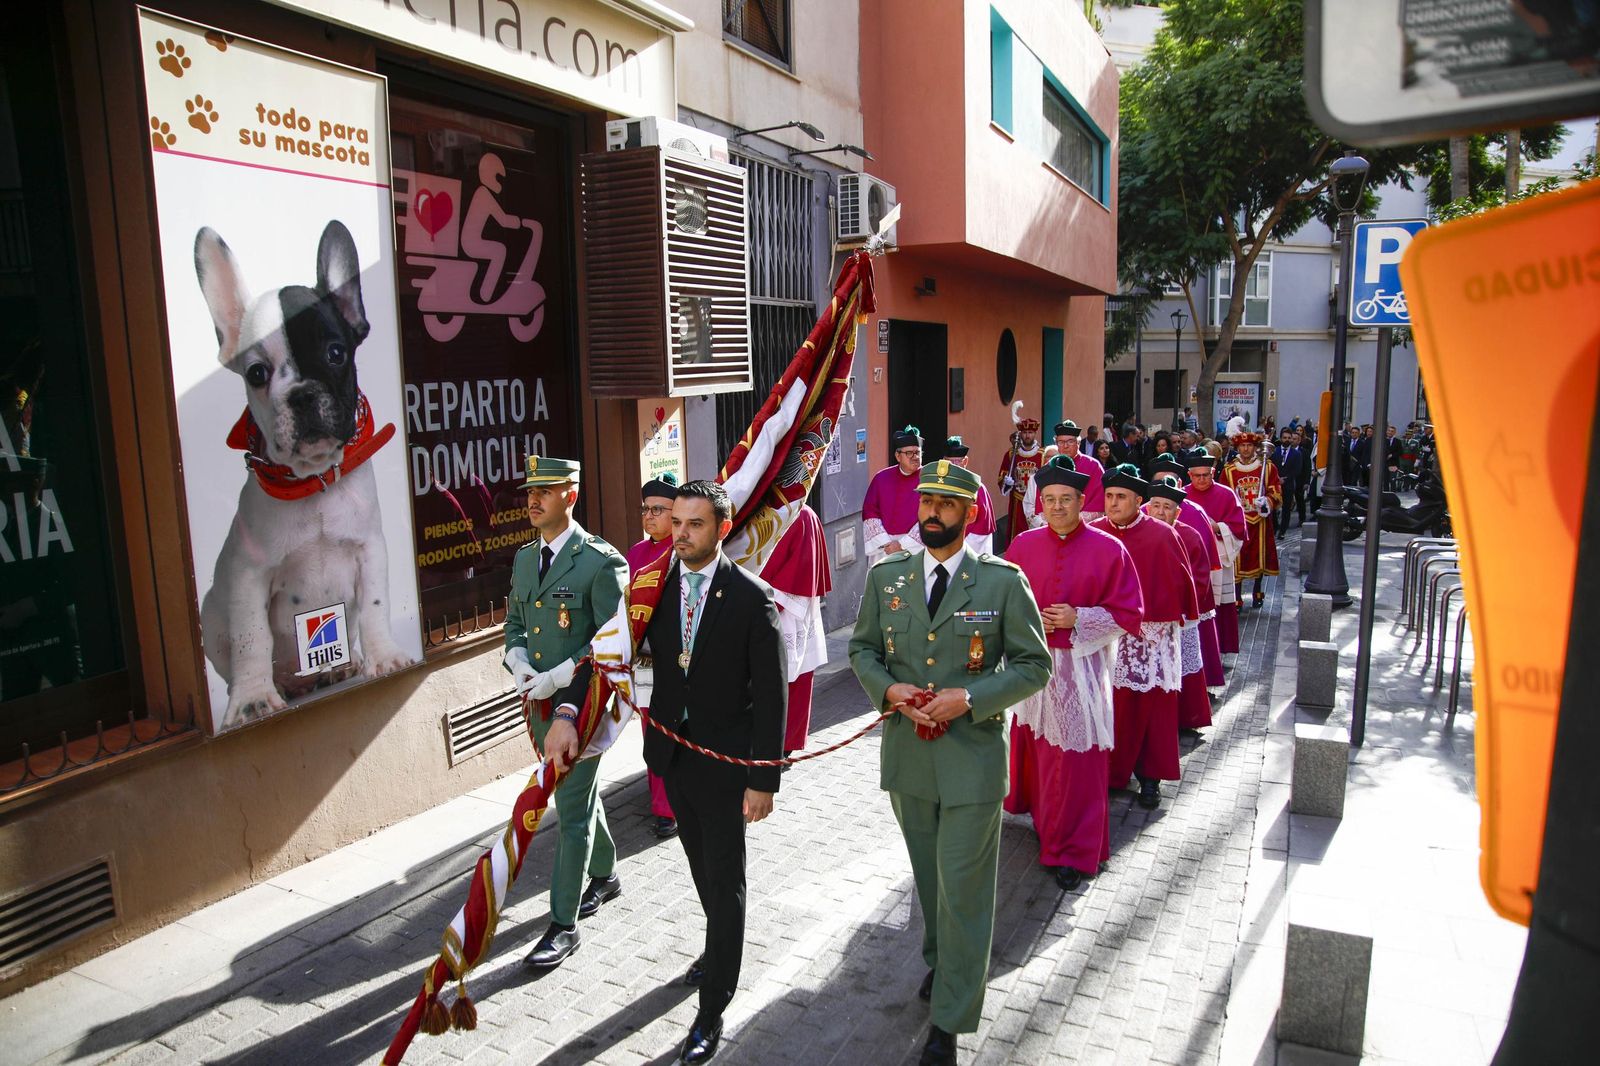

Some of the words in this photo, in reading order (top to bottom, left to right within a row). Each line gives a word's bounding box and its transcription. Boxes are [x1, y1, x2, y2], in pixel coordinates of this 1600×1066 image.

[256, 103, 311, 132] todo
[319, 120, 369, 144] para
[239, 128, 266, 148] su
[275, 135, 370, 167] mascota
[1365, 227, 1413, 284] P
[405, 378, 526, 433] REPARTO
[534, 377, 550, 422] A
[649, 457, 679, 470] Teléfonos
[424, 518, 474, 541] PIENSOS
[307, 645, 343, 669] Hill's
